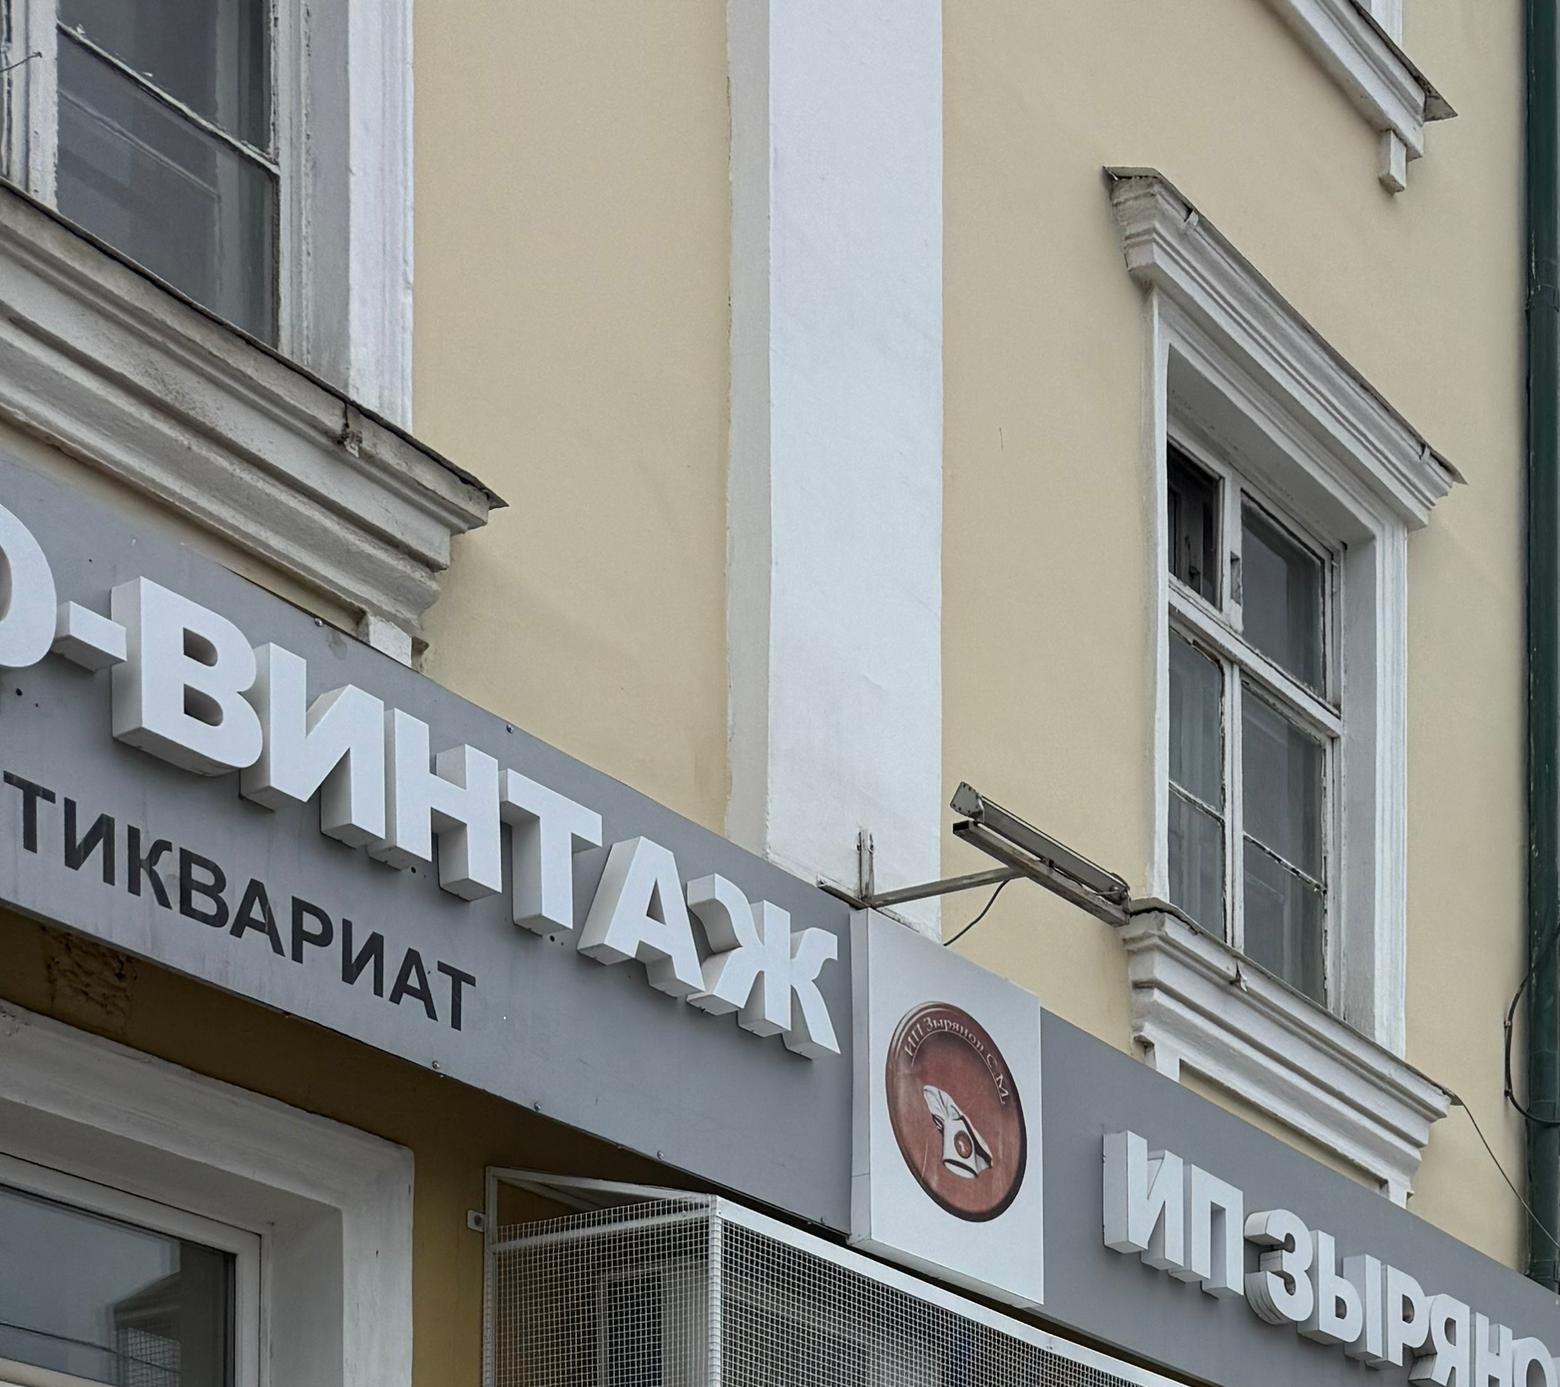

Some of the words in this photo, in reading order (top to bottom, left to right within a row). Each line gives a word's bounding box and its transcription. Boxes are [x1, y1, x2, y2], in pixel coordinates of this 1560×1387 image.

[3, 769, 477, 1032] ТИКВАРИАТ
[904, 1023, 925, 1057] ИП
[924, 1016, 984, 1053] Зырянов
[1103, 1130, 1245, 1301] ИП
